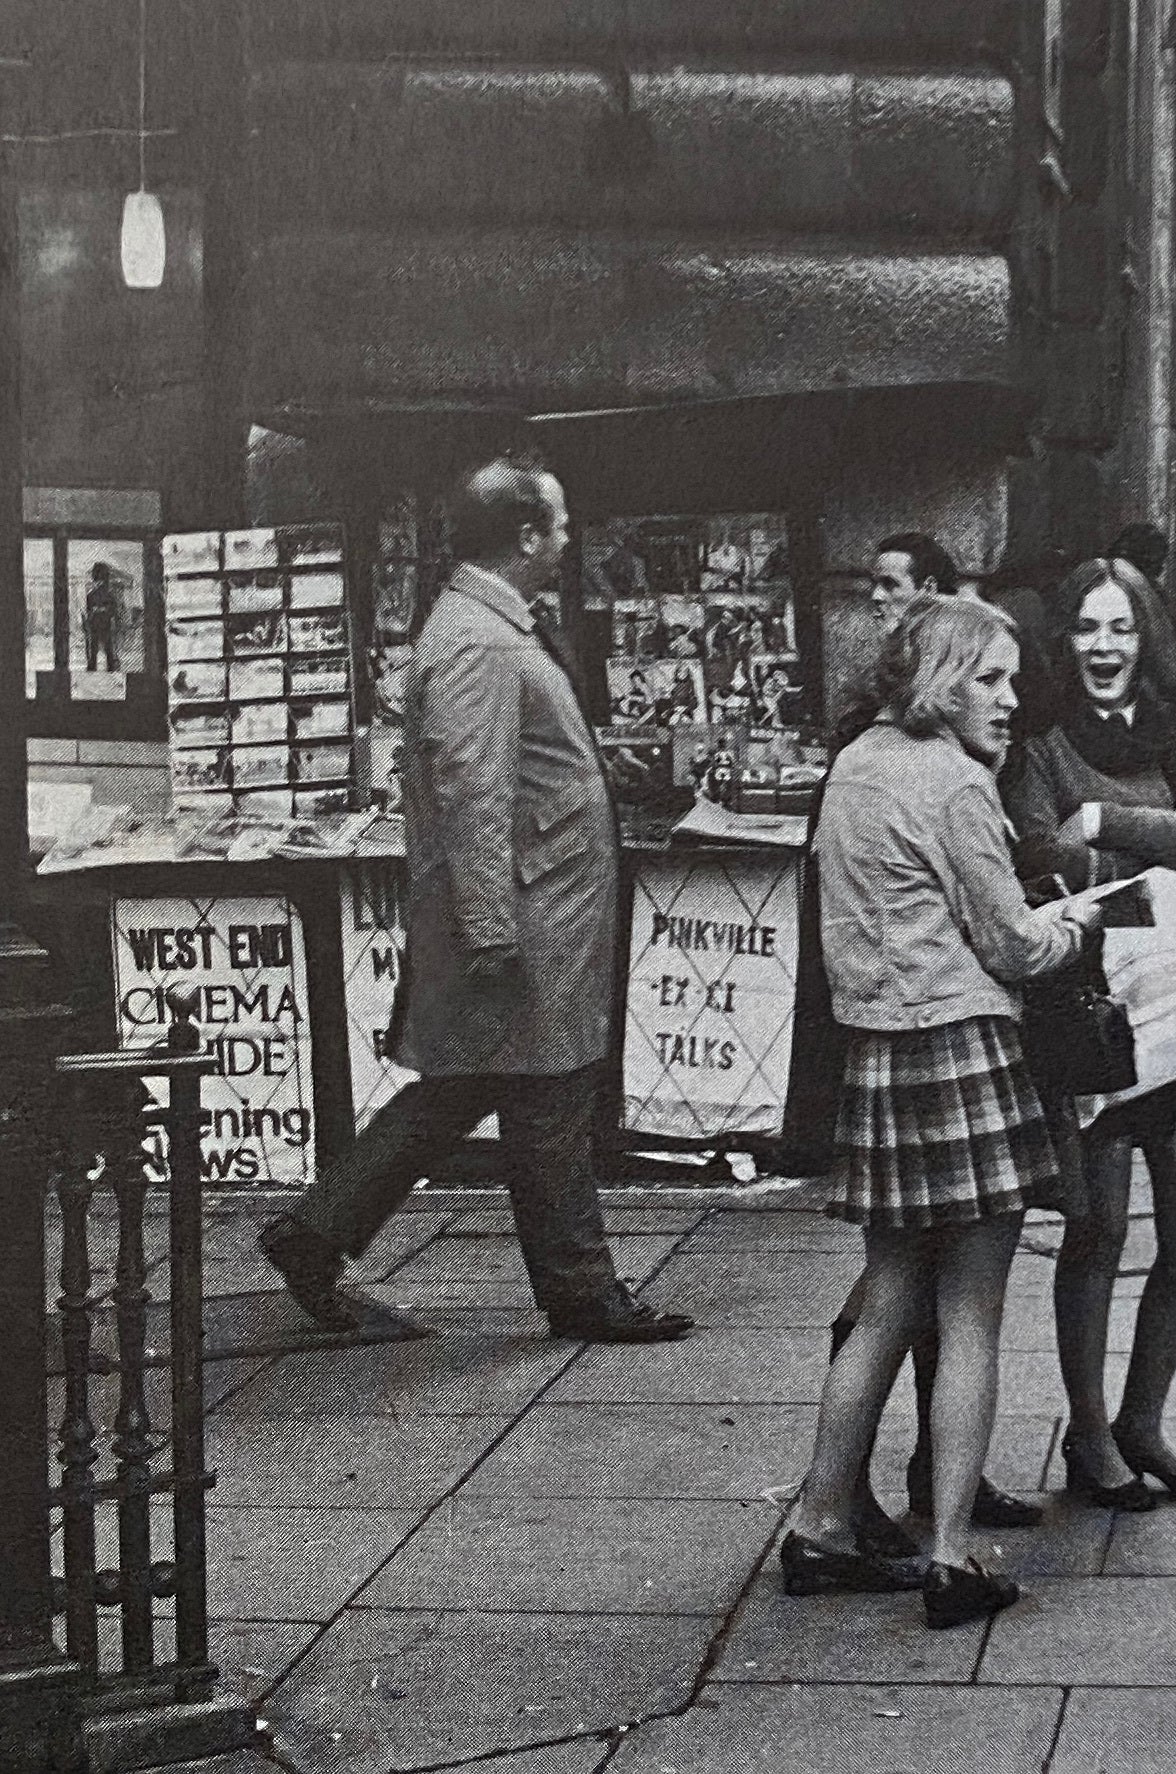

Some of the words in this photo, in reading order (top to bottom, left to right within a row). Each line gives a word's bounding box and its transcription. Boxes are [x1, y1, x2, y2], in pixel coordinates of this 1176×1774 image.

[127, 927, 216, 972] WEST
[228, 922, 292, 969] END
[651, 911, 777, 957] PINKVILLE
[206, 1036, 288, 1078] IDE
[656, 1032, 737, 1071] TALKS
[200, 1098, 312, 1147] ning
